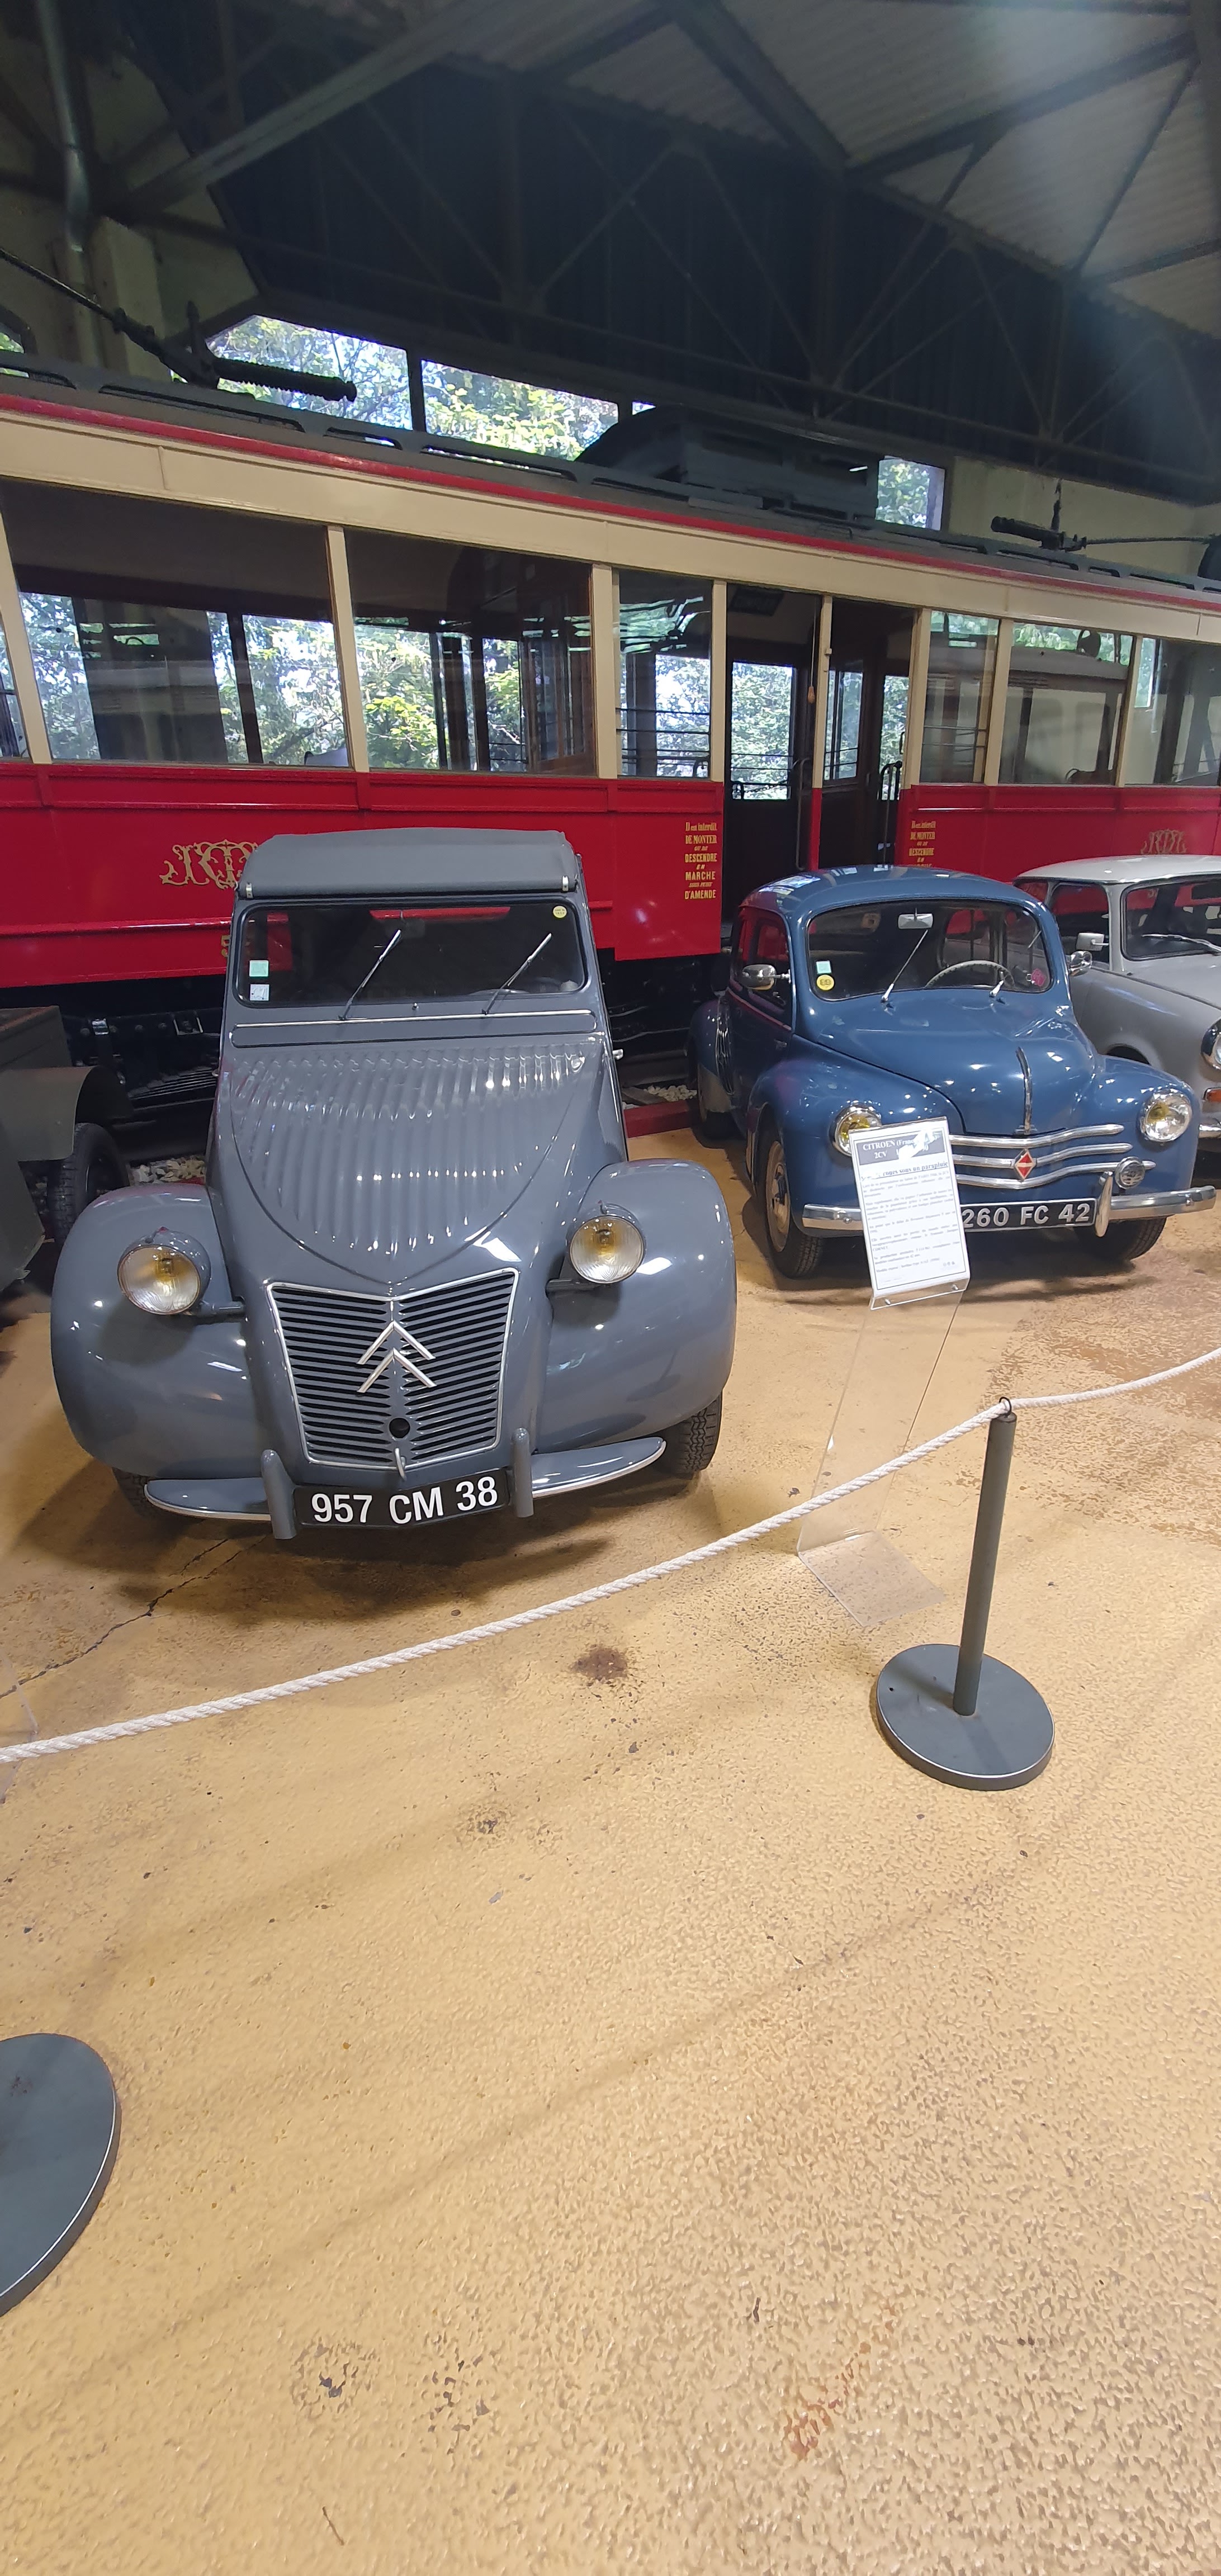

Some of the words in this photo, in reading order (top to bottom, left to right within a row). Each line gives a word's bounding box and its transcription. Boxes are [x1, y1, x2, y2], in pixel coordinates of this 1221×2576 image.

[698, 822, 717, 831] interdit
[685, 835, 693, 844] DE
[693, 835, 717, 844] MONTER
[685, 853, 717, 863] DESCENDRE
[685, 871, 716, 880] MARCHE
[685, 889, 717, 899] D'AMENDE
[874, 1150, 888, 1159] 2CV
[922, 1161, 948, 1172] parapluie
[962, 1207, 1009, 1228] 260
[1020, 1205, 1049, 1225] FC
[1058, 1203, 1090, 1223] 42
[311, 1493, 372, 1523] 957
[389, 1486, 444, 1524] CM
[455, 1476, 498, 1512] 38
